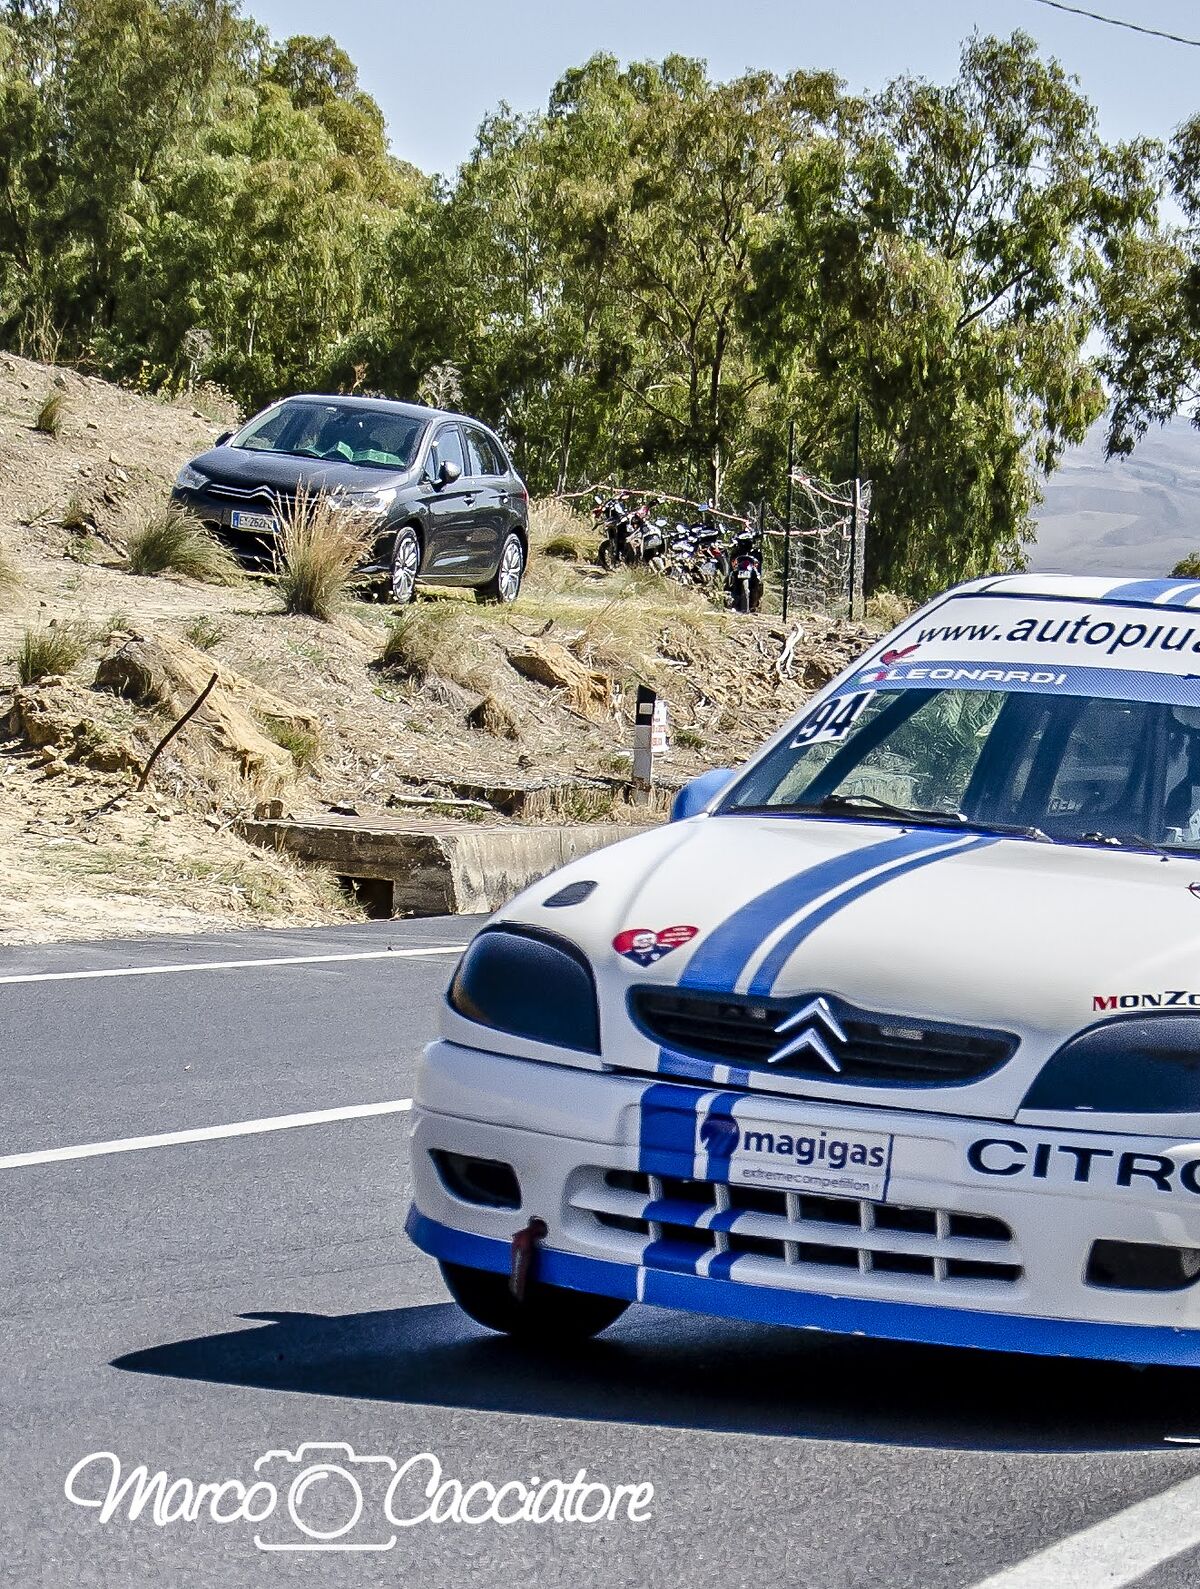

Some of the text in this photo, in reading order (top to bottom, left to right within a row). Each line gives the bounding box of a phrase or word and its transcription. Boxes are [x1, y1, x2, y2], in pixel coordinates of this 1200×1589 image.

[886, 668, 1067, 685] LEONARDI
[795, 690, 869, 744] 94
[744, 1131, 885, 1170] magigas
